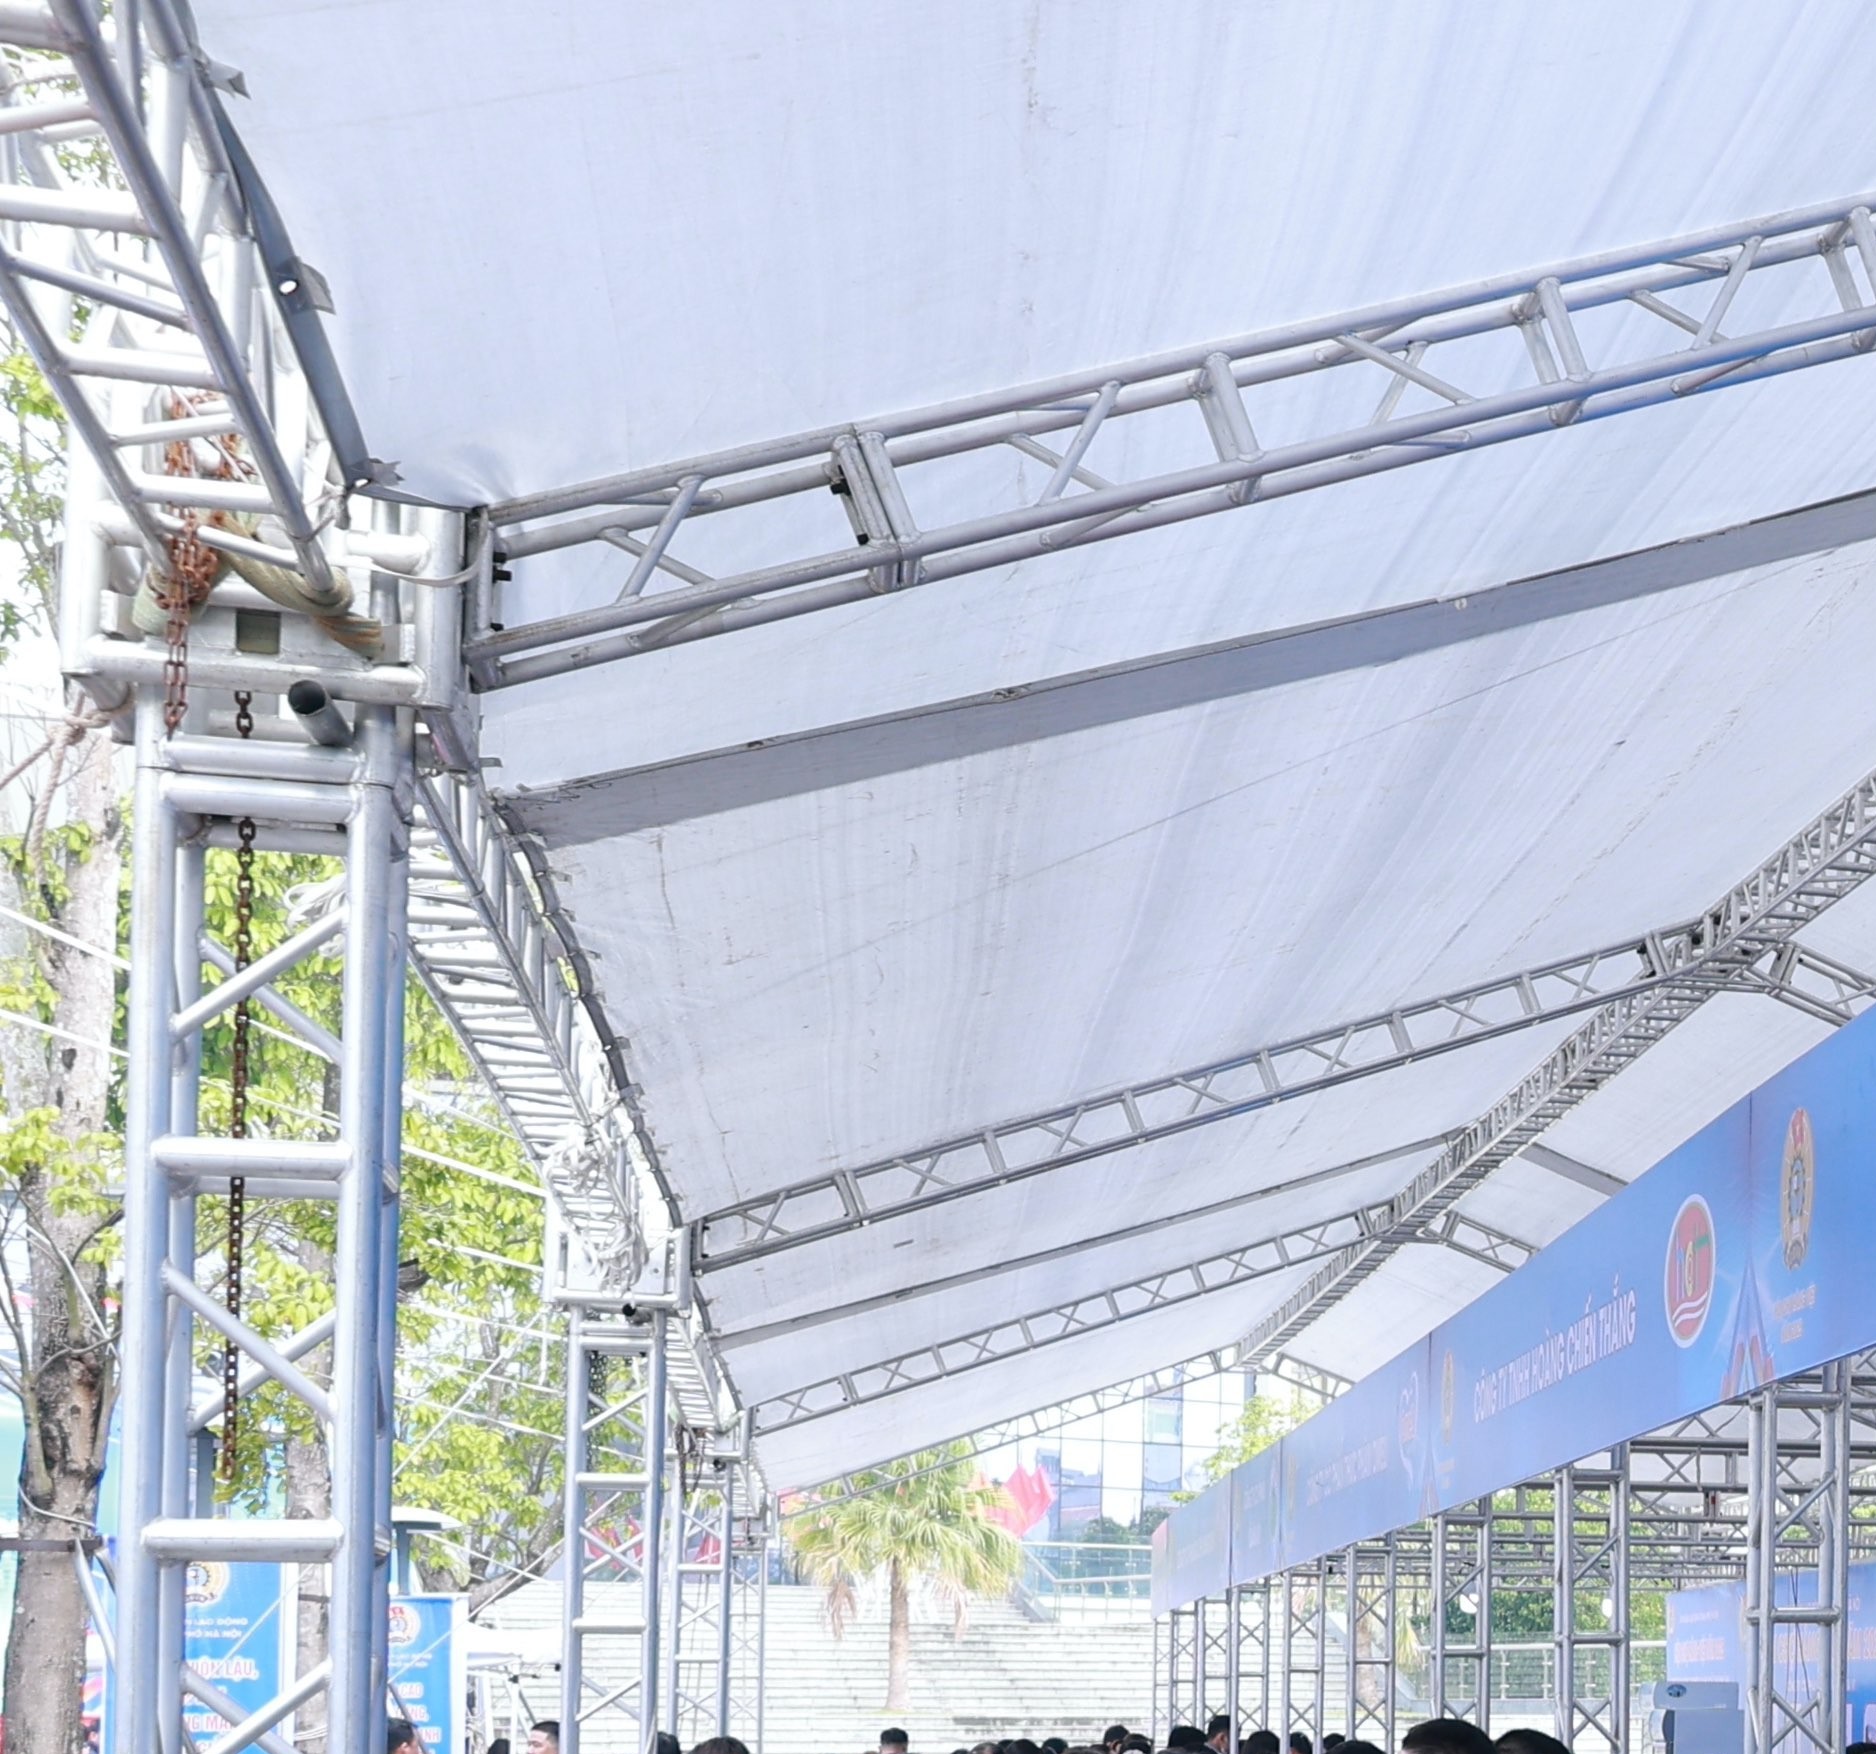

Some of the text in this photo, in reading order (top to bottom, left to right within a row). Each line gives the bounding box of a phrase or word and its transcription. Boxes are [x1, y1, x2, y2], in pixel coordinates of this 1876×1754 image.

[1474, 1272, 1637, 1424] CÔNG TY TNHH HOÀNG CHIẾN THẮNG
